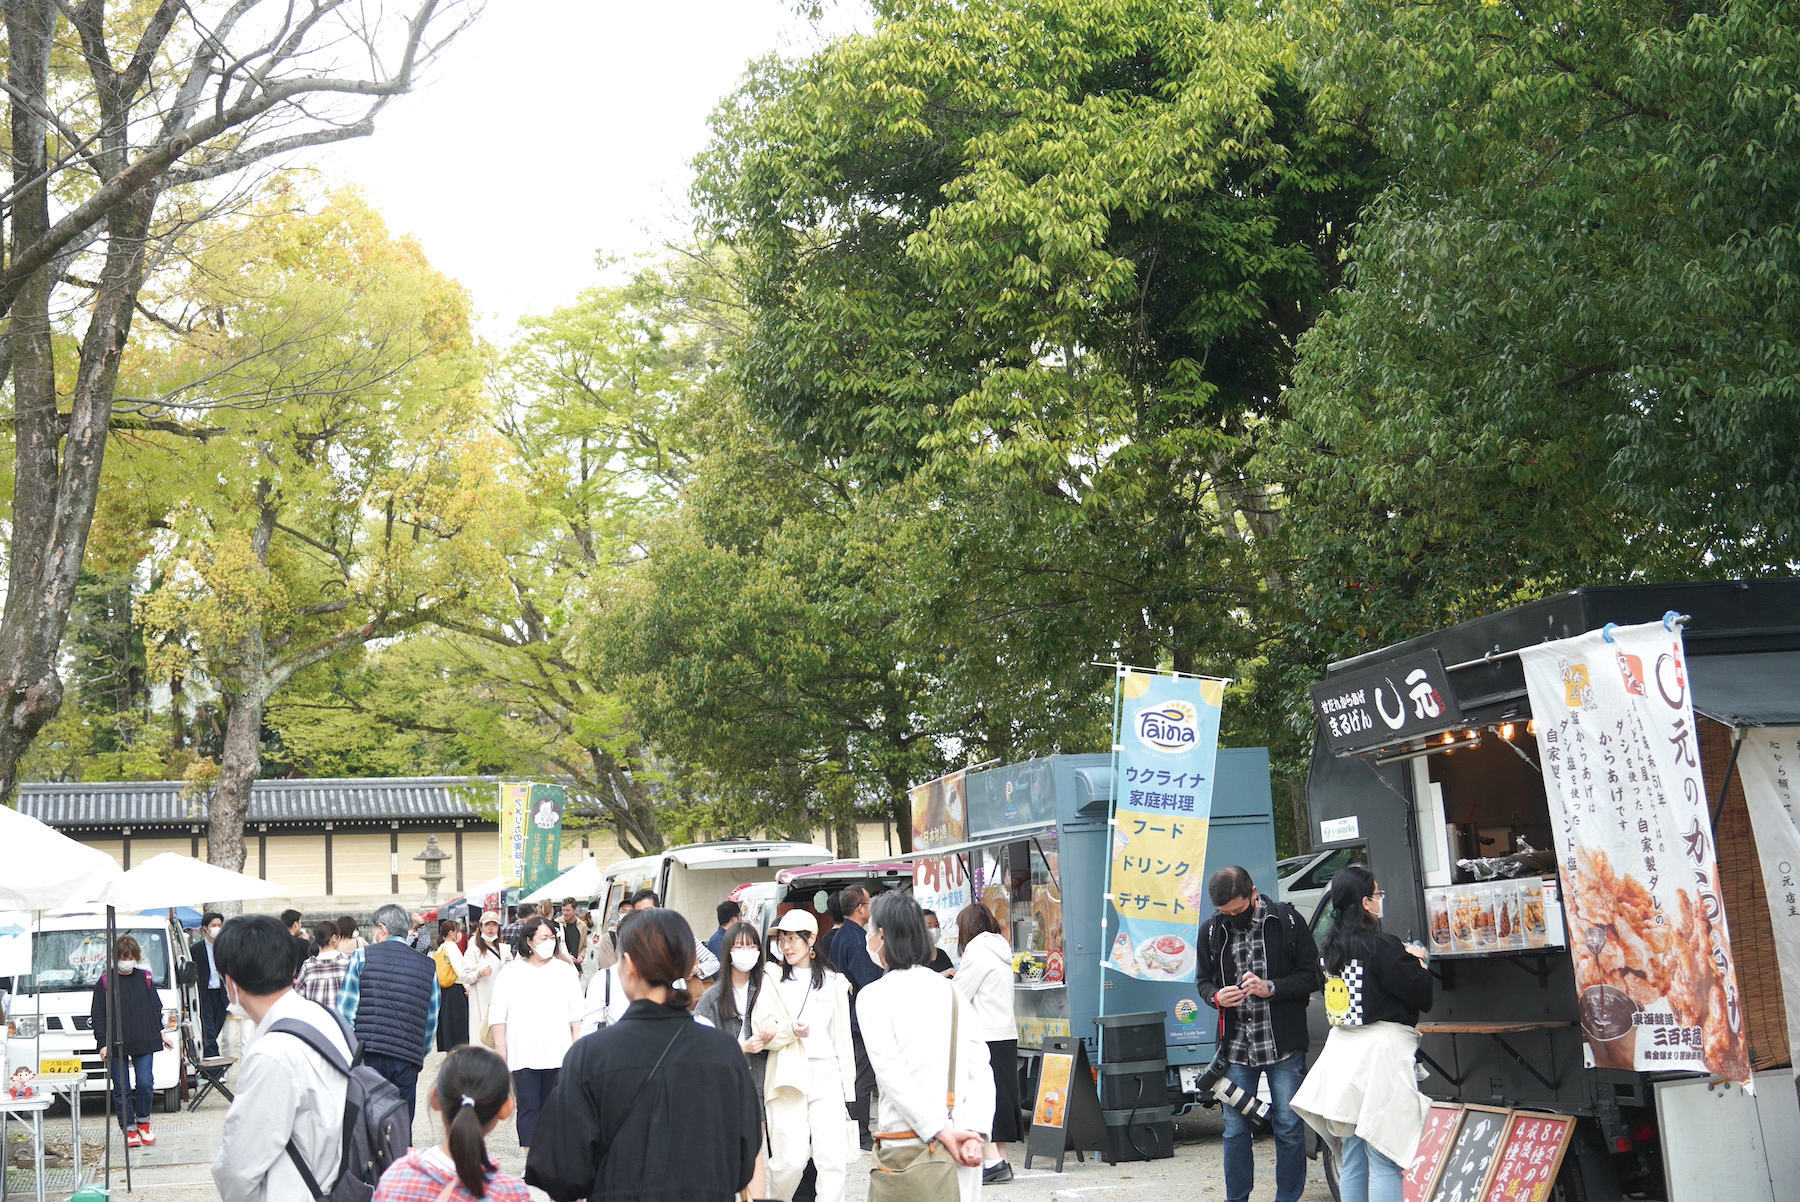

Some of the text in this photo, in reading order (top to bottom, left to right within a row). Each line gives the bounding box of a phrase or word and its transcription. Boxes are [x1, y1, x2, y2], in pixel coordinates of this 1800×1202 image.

[1329, 709, 1373, 737] まるげん
[1570, 711, 1596, 813] 塩からあげは
[1126, 766, 1205, 789] ウクライナ
[1599, 732, 1628, 831] からあげです
[1129, 790, 1195, 811] 家庭料理
[1133, 820, 1184, 839] フード
[1123, 855, 1190, 877] ドリンク
[1119, 892, 1185, 914] デザート
[1653, 1027, 1702, 1046] 三百年蔵
